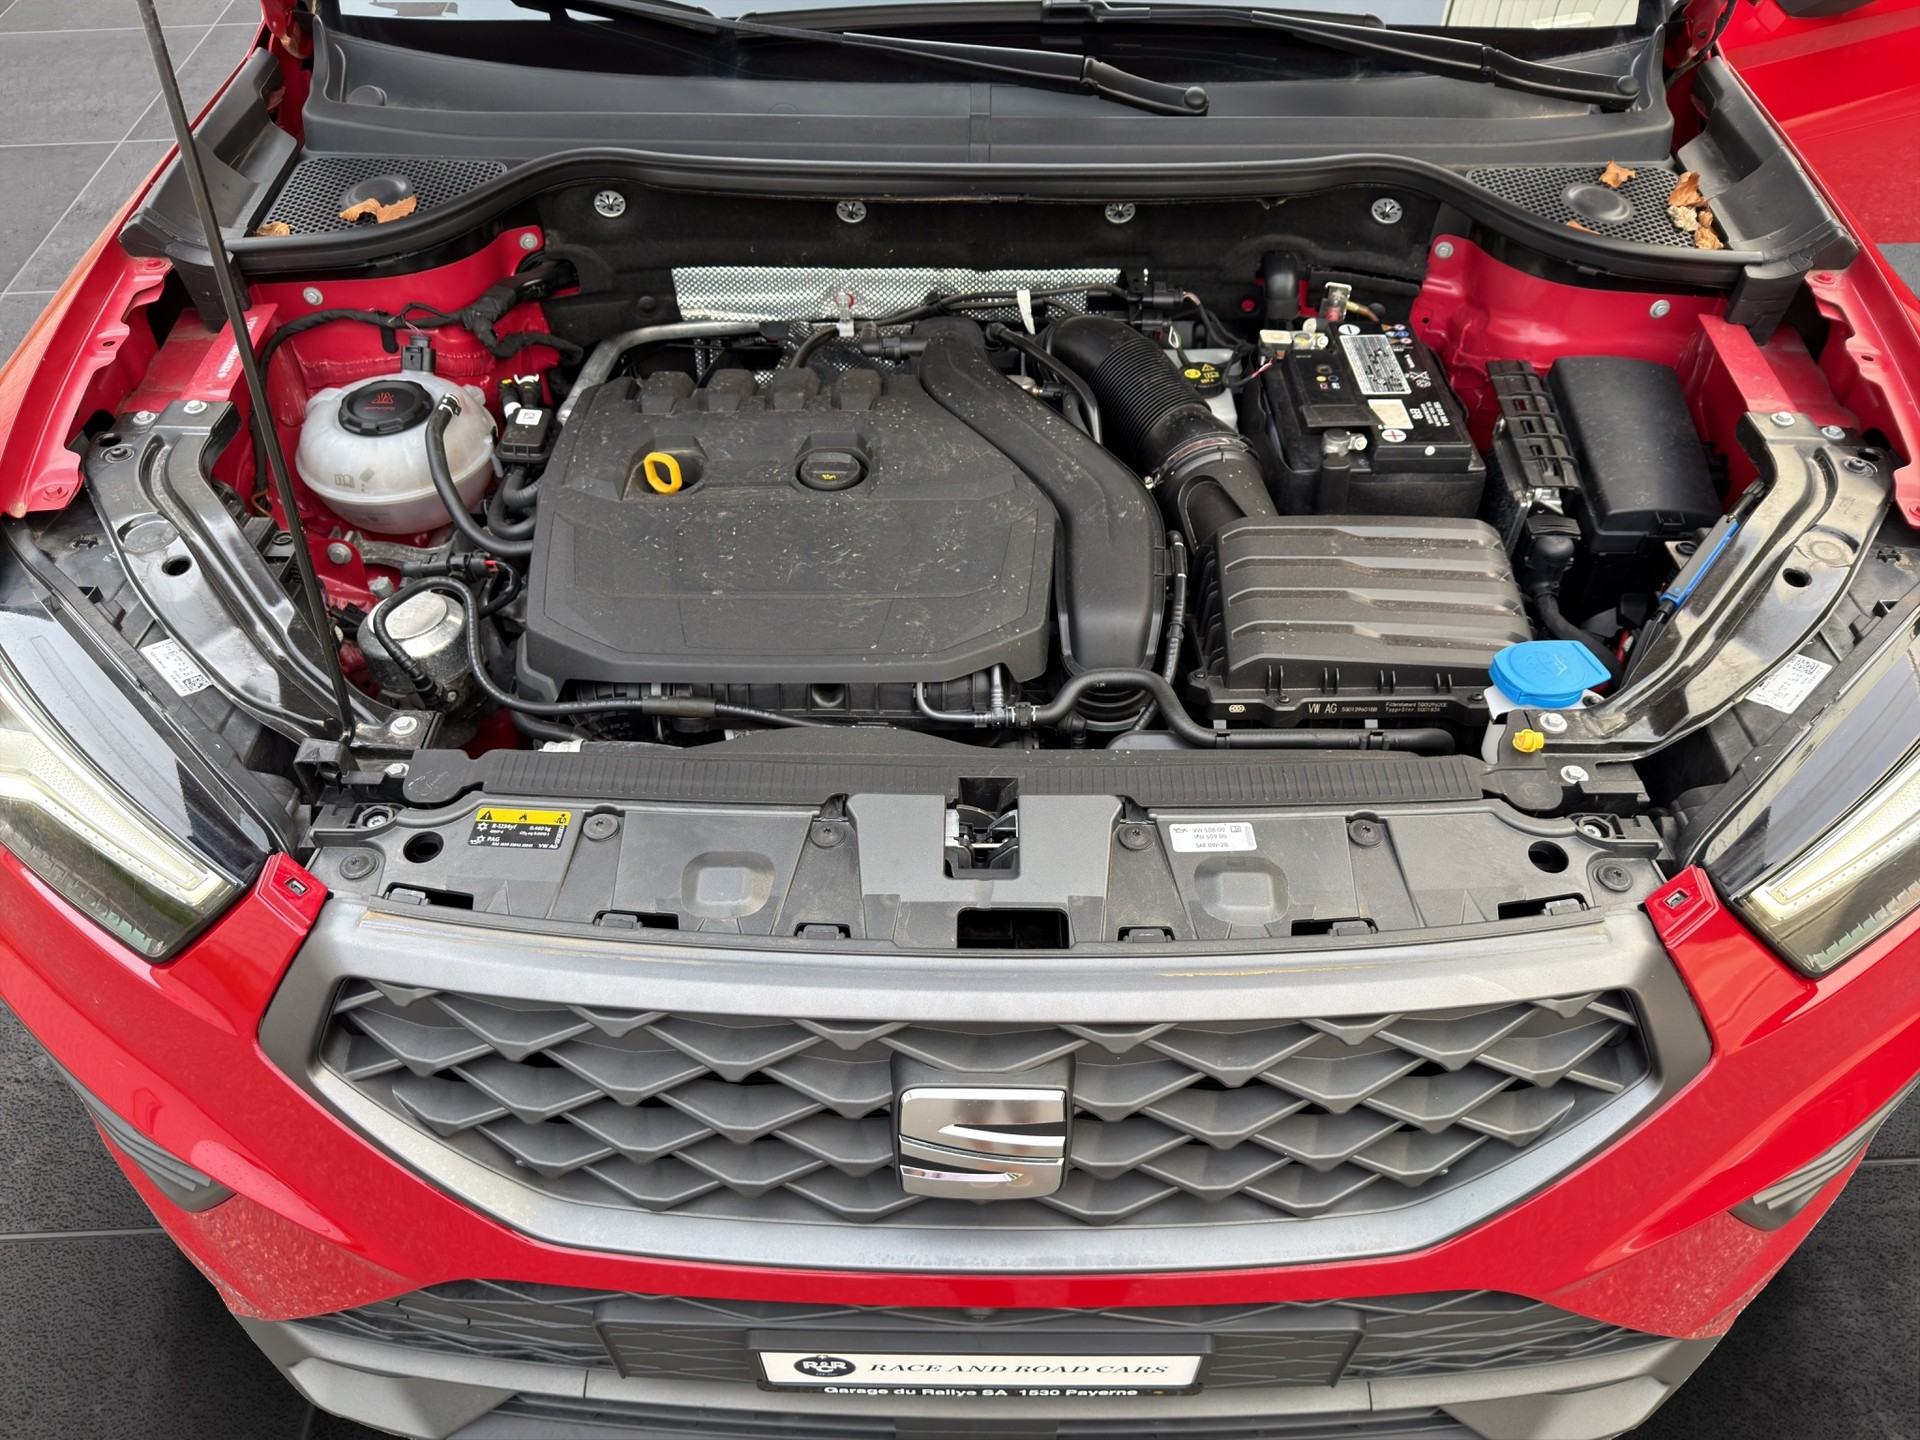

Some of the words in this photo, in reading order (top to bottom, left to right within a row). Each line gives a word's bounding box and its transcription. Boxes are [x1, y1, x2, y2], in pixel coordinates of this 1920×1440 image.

[1308, 703, 1320, 714] VW
[1324, 703, 1338, 714] AG
[870, 1363, 943, 1372] RACE
[948, 1364, 1008, 1373] AND
[1014, 1365, 1090, 1374] ROAD
[1096, 1365, 1169, 1374] CARS
[824, 1386, 888, 1396] Garage
[893, 1387, 916, 1395] du
[922, 1388, 977, 1397] Rallye
